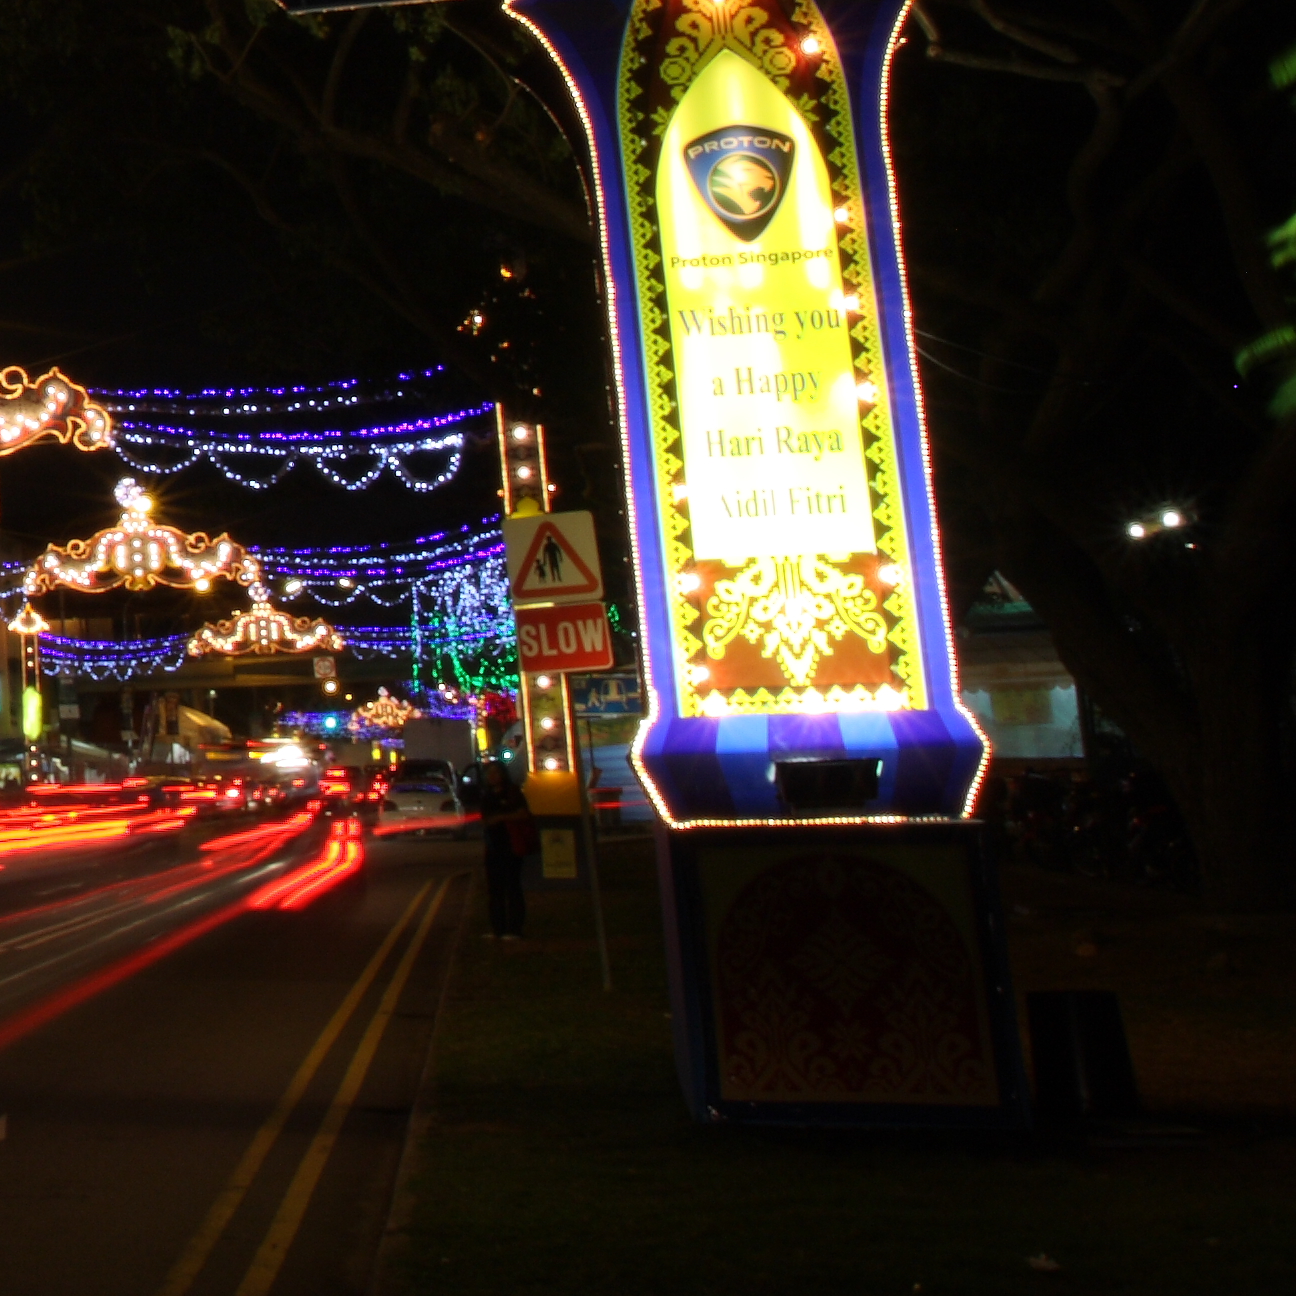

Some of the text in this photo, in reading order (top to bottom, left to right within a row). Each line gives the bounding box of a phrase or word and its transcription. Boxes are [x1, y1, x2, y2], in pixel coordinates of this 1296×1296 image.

[687, 134, 792, 161] PROTON
[670, 247, 834, 269] Proton Singapore
[677, 306, 842, 341] Wishing you
[711, 367, 821, 401] a Happy
[705, 425, 844, 462] Hari Raya
[519, 617, 605, 658] SLOW
